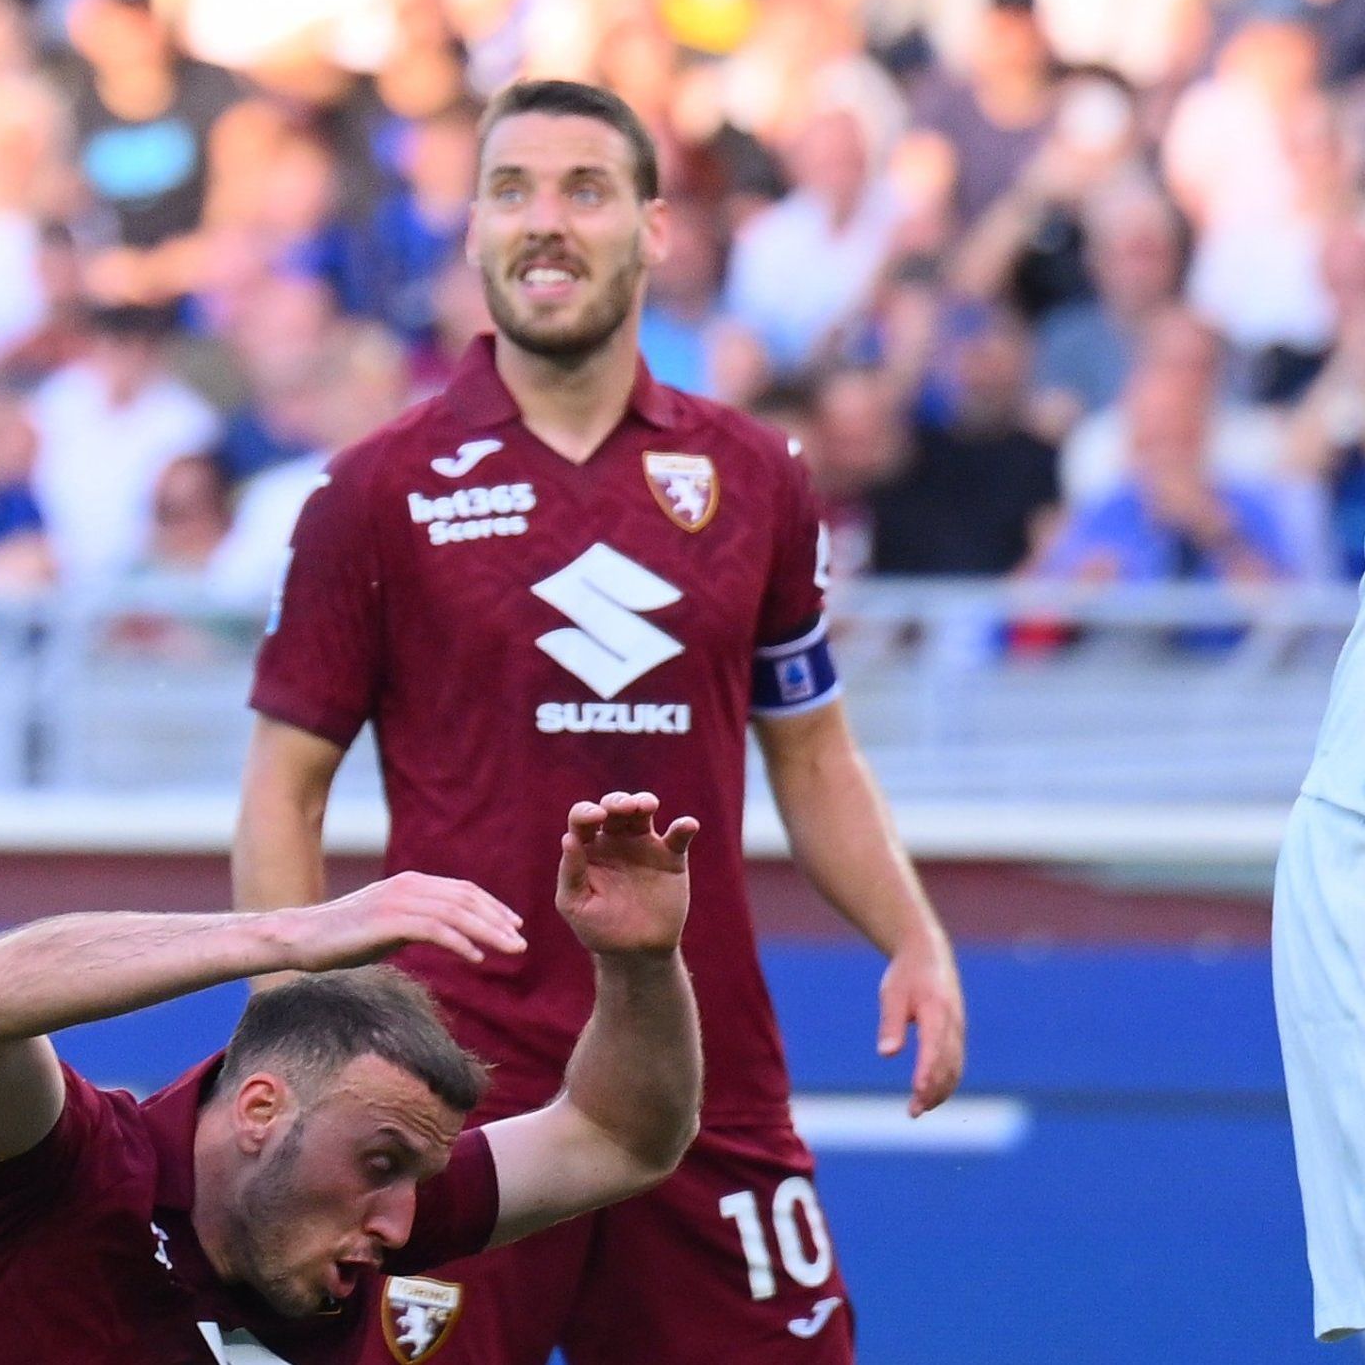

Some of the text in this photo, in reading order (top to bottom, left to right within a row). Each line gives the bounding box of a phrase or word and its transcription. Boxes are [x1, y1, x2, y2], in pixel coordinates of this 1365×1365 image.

[407, 482, 538, 524] bet365
[535, 701, 692, 734] SUZUKI
[719, 1175, 833, 1301] 10
